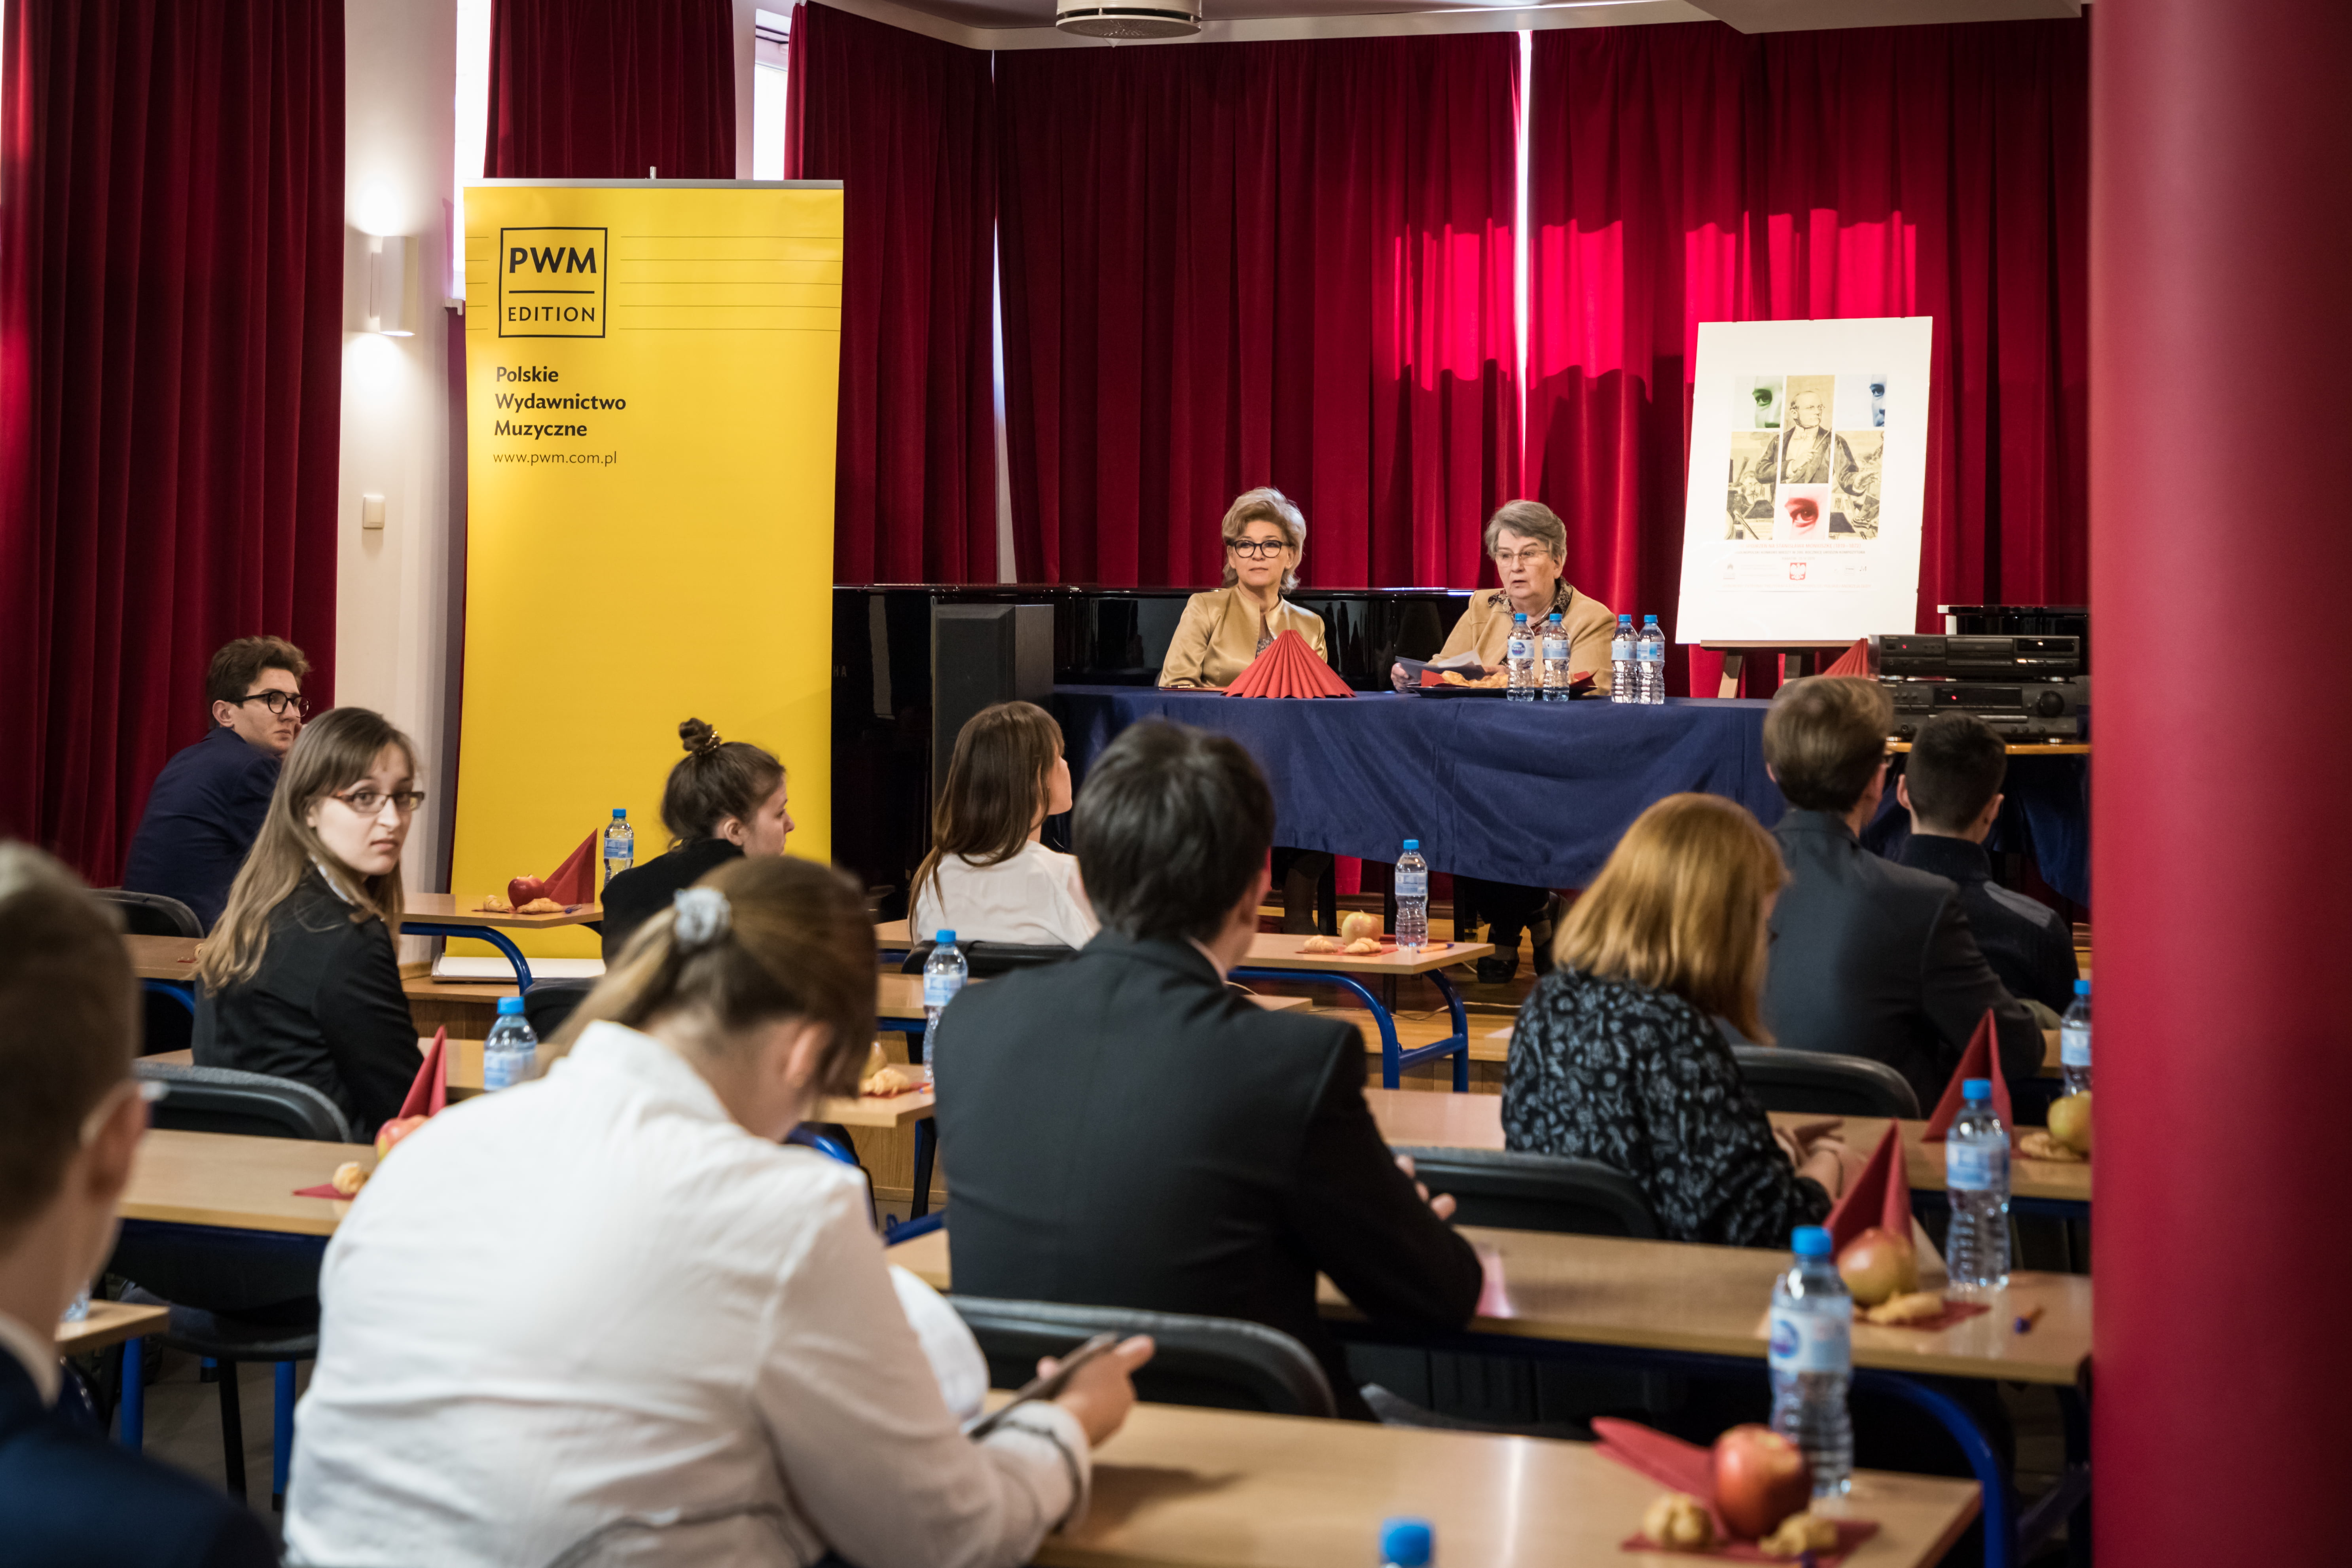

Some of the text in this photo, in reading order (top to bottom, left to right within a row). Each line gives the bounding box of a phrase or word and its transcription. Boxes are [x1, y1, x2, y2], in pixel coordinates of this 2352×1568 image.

[509, 247, 597, 274] PWM
[508, 306, 595, 322] EDITION
[496, 365, 559, 383] Polskie
[495, 392, 626, 413] Wydawnictwo
[494, 420, 588, 440] Muzyczne
[493, 450, 617, 467] www.pwm.com.pl
